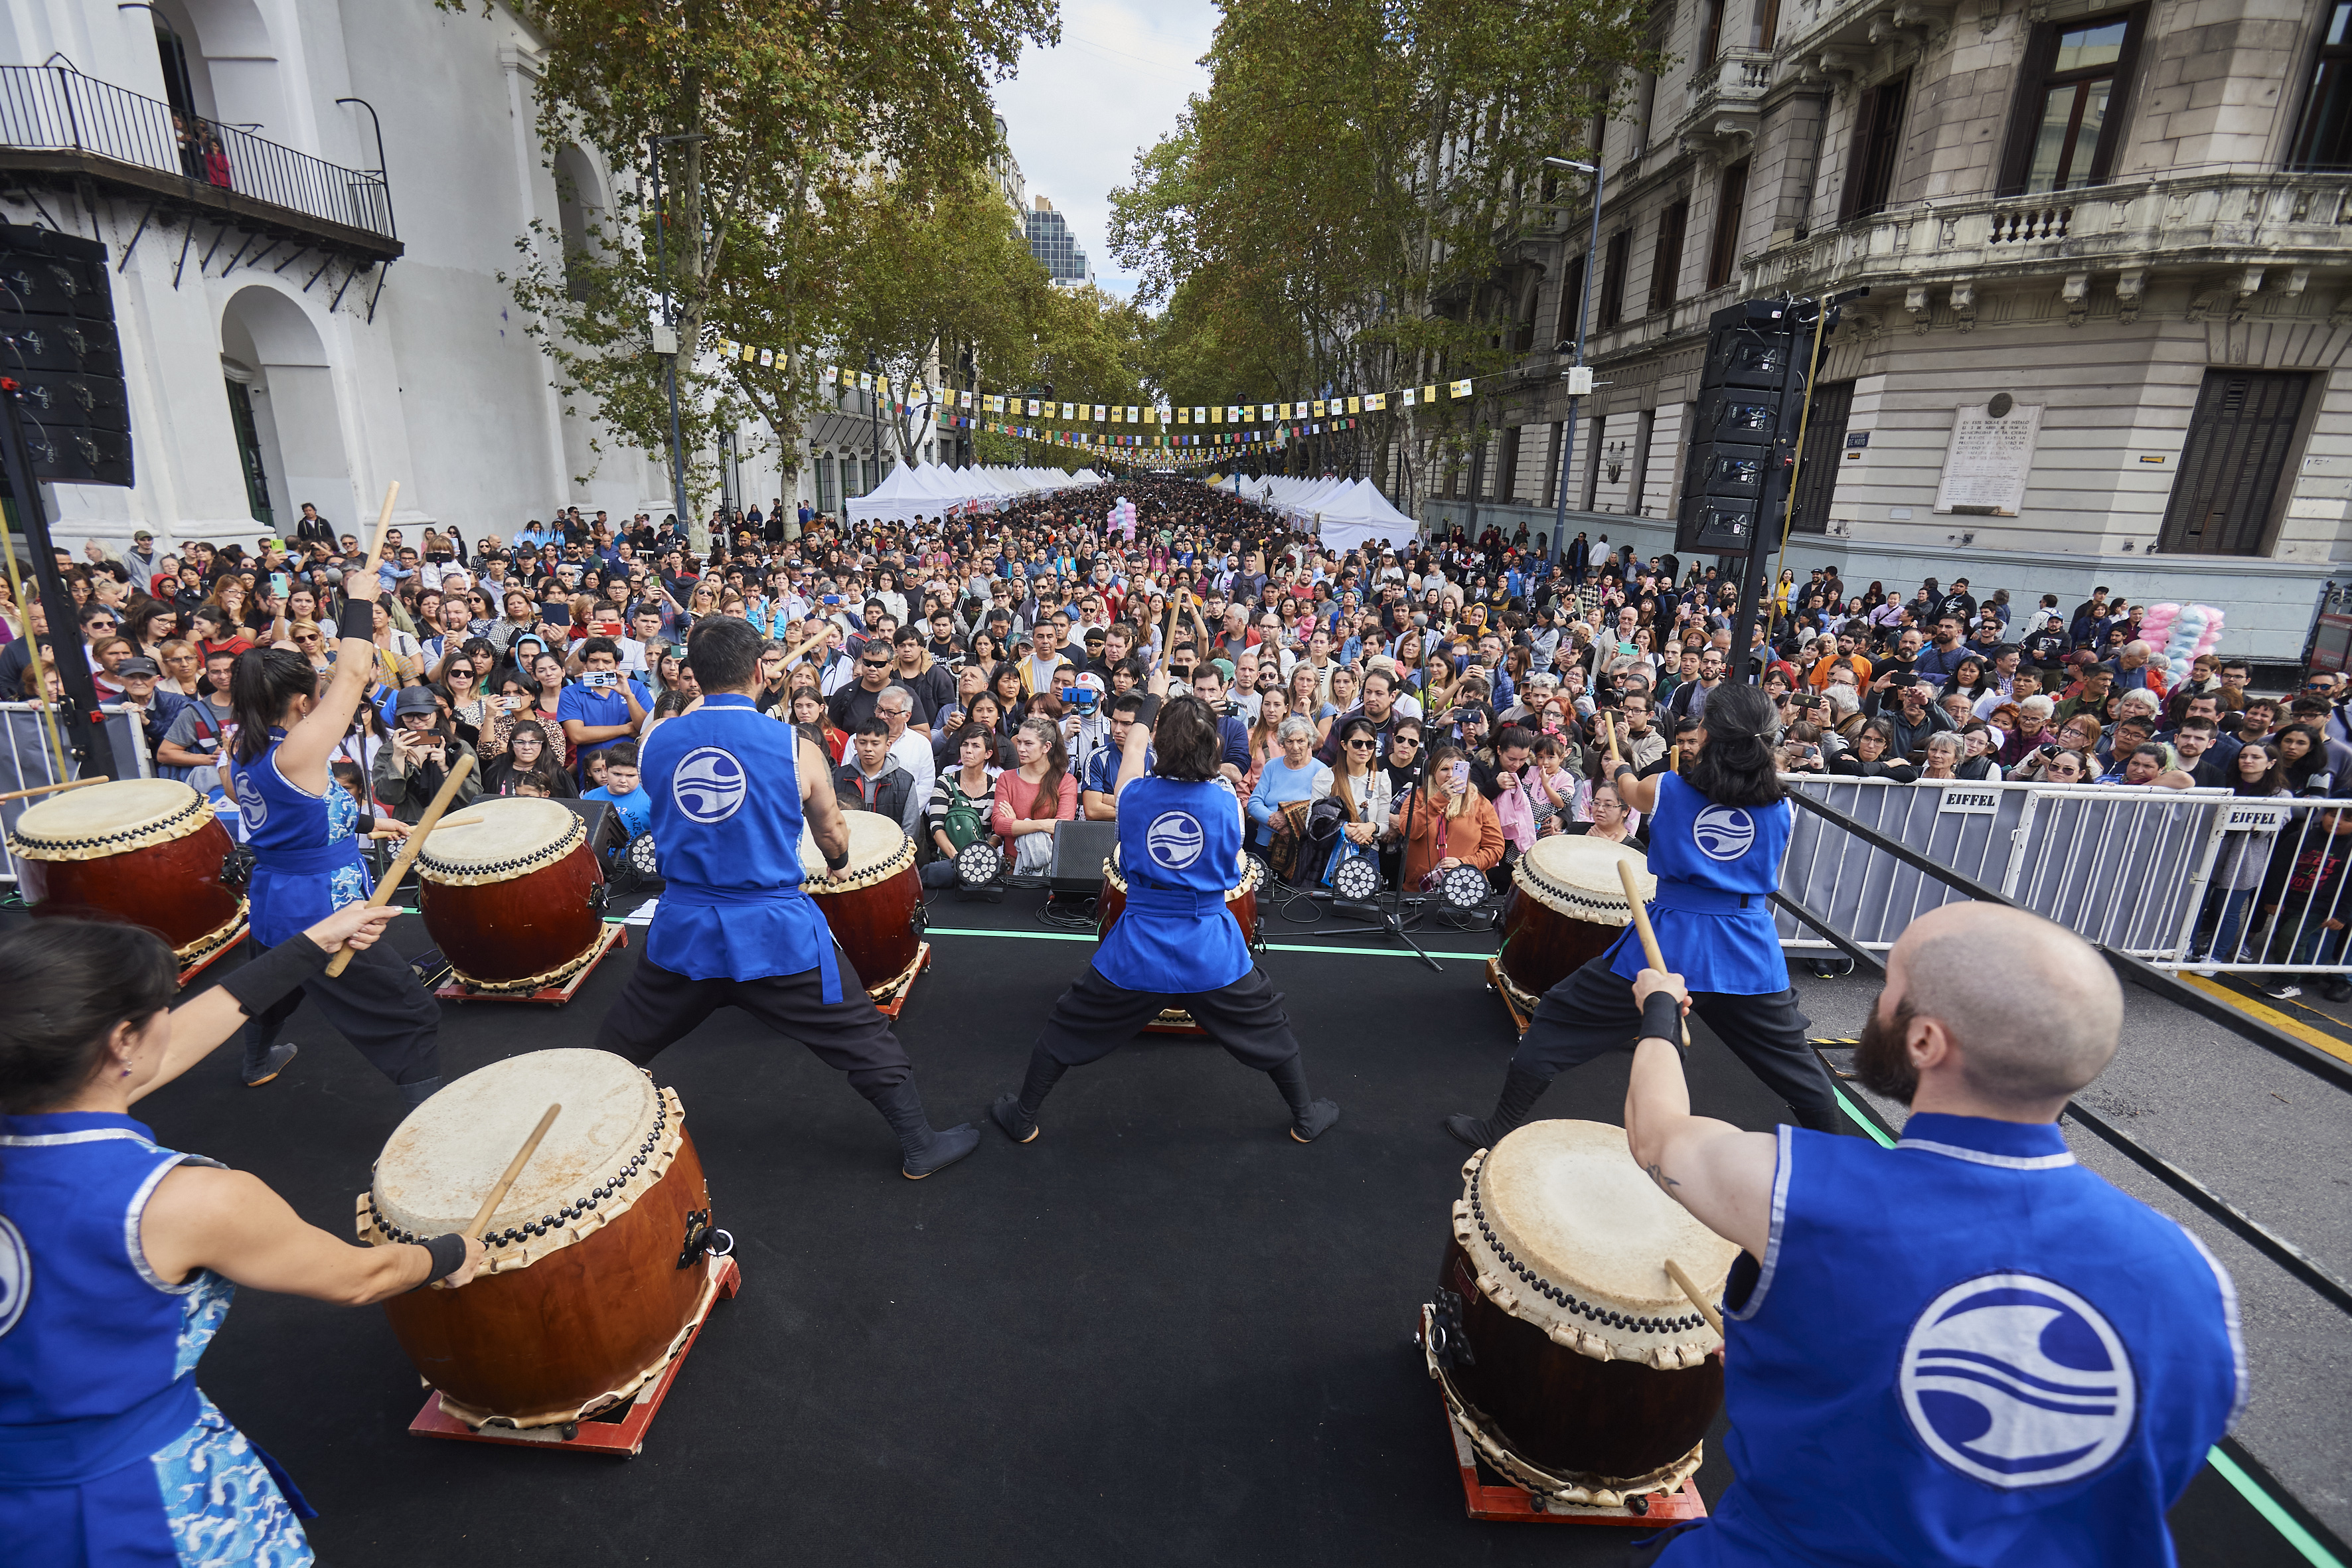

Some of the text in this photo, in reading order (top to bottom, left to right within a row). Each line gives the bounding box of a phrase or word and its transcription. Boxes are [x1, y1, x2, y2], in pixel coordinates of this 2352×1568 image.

[594, 675, 604, 684] 10
[1946, 793, 1995, 807] EIFFEL
[2230, 812, 2276, 824] EIFFEL
